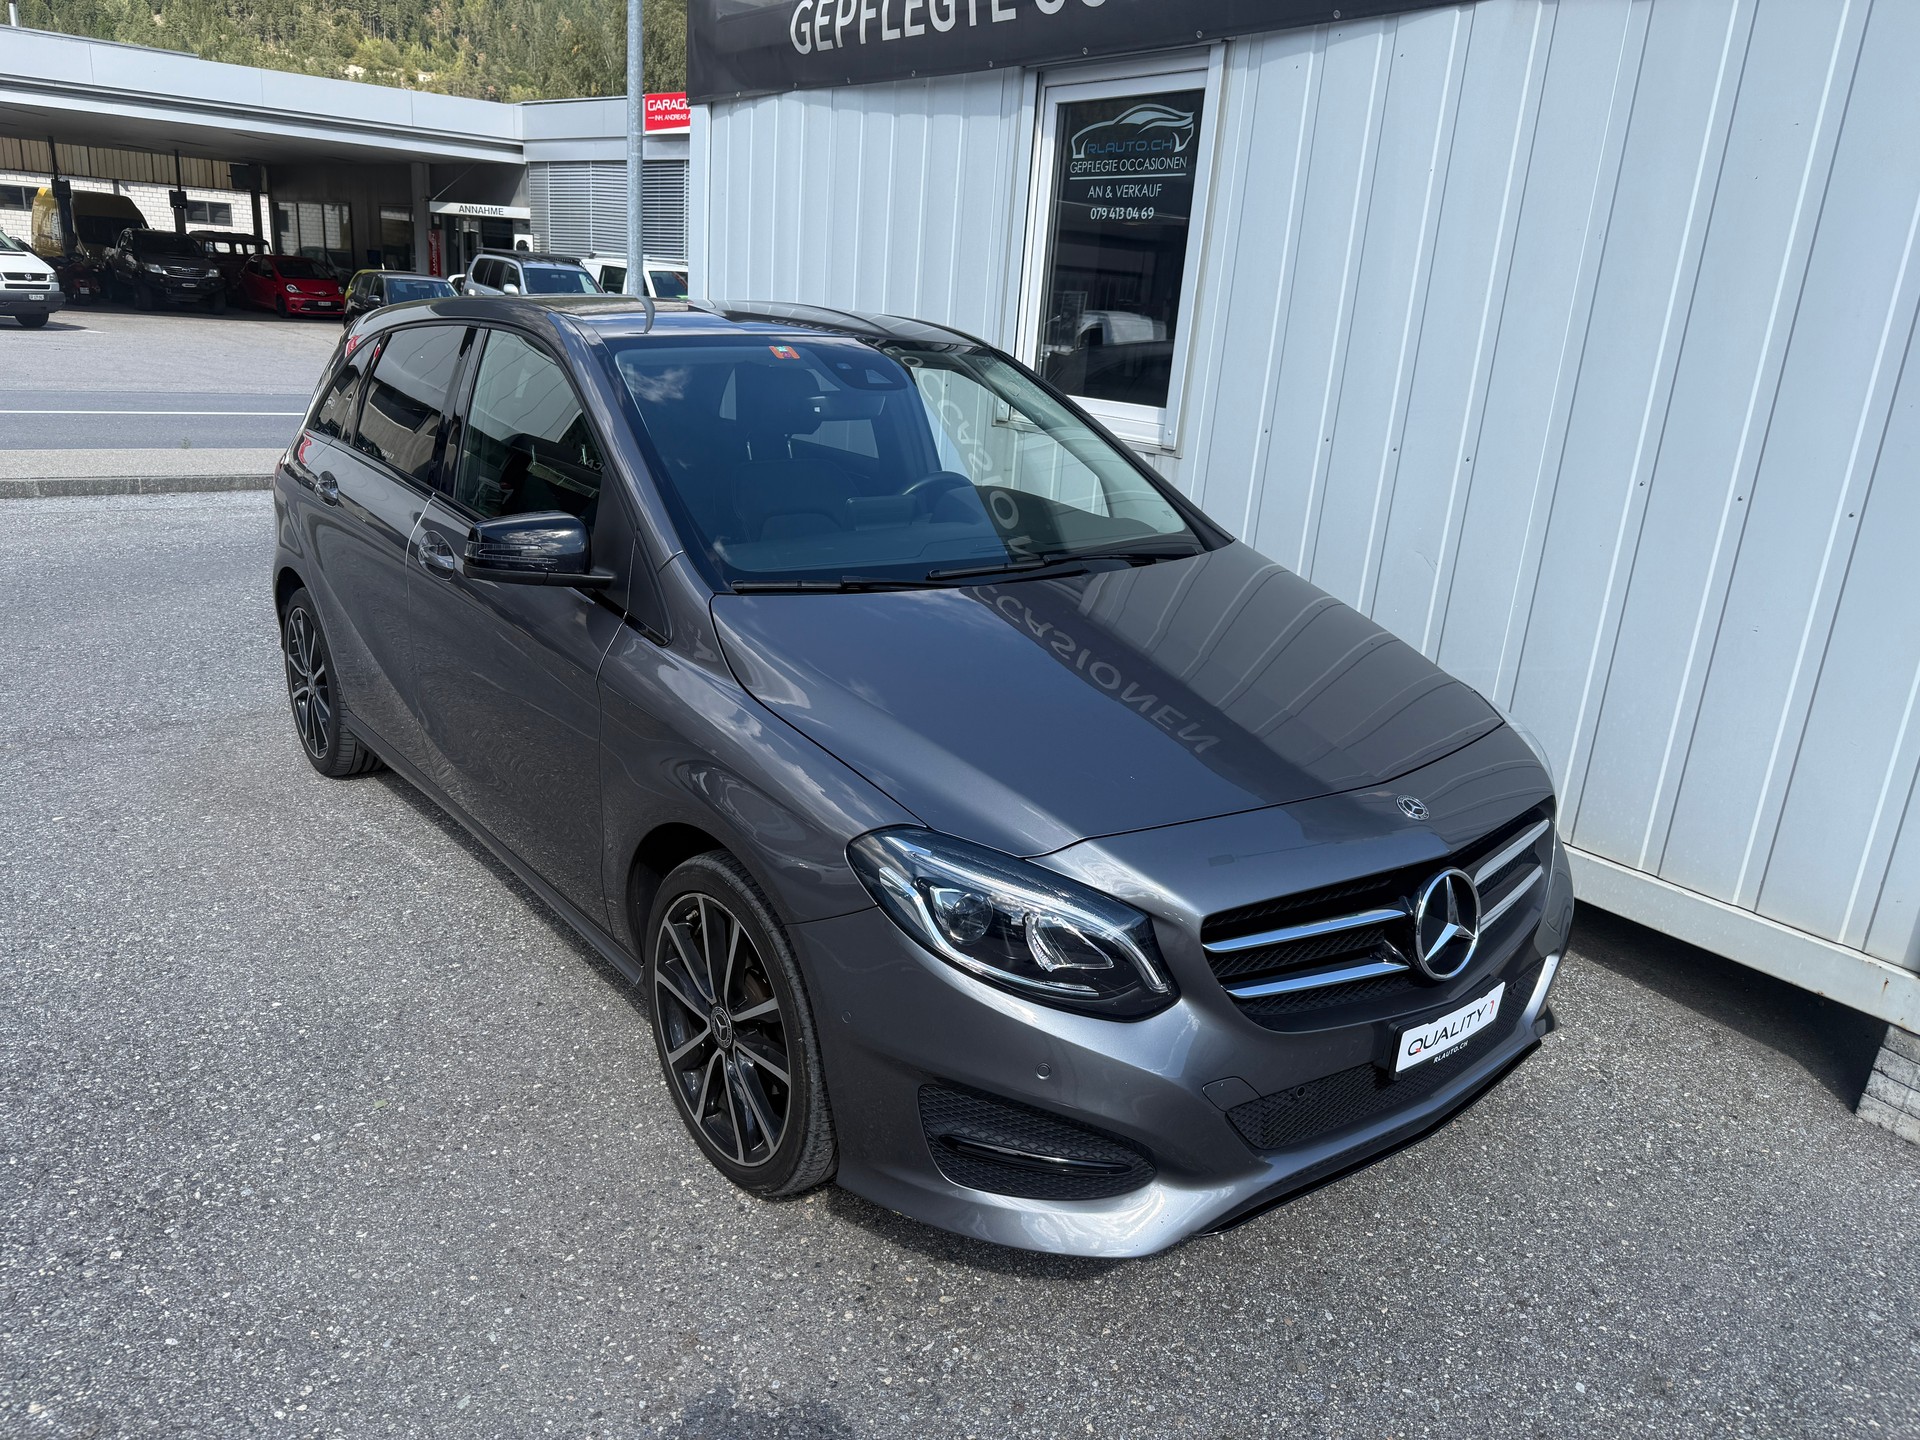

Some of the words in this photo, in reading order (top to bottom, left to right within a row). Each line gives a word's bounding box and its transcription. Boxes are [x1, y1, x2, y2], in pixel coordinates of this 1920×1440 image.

[664, 113, 687, 121] ANDREAS
[1087, 138, 1173, 154] RLAUTO.CH
[1070, 159, 1117, 173] GEPFLEGTE
[1119, 157, 1187, 172] OCCASIONEN
[1087, 185, 1103, 198] AN
[1105, 186, 1113, 198] &
[1116, 184, 1162, 198] VERKAUF
[458, 205, 504, 216] ANNAHME
[1090, 207, 1107, 220] 079
[1109, 207, 1124, 220] 413
[1126, 207, 1139, 220] 04
[1141, 206, 1155, 219] 69
[1433, 1040, 1469, 1064] RLAUTO.CH
